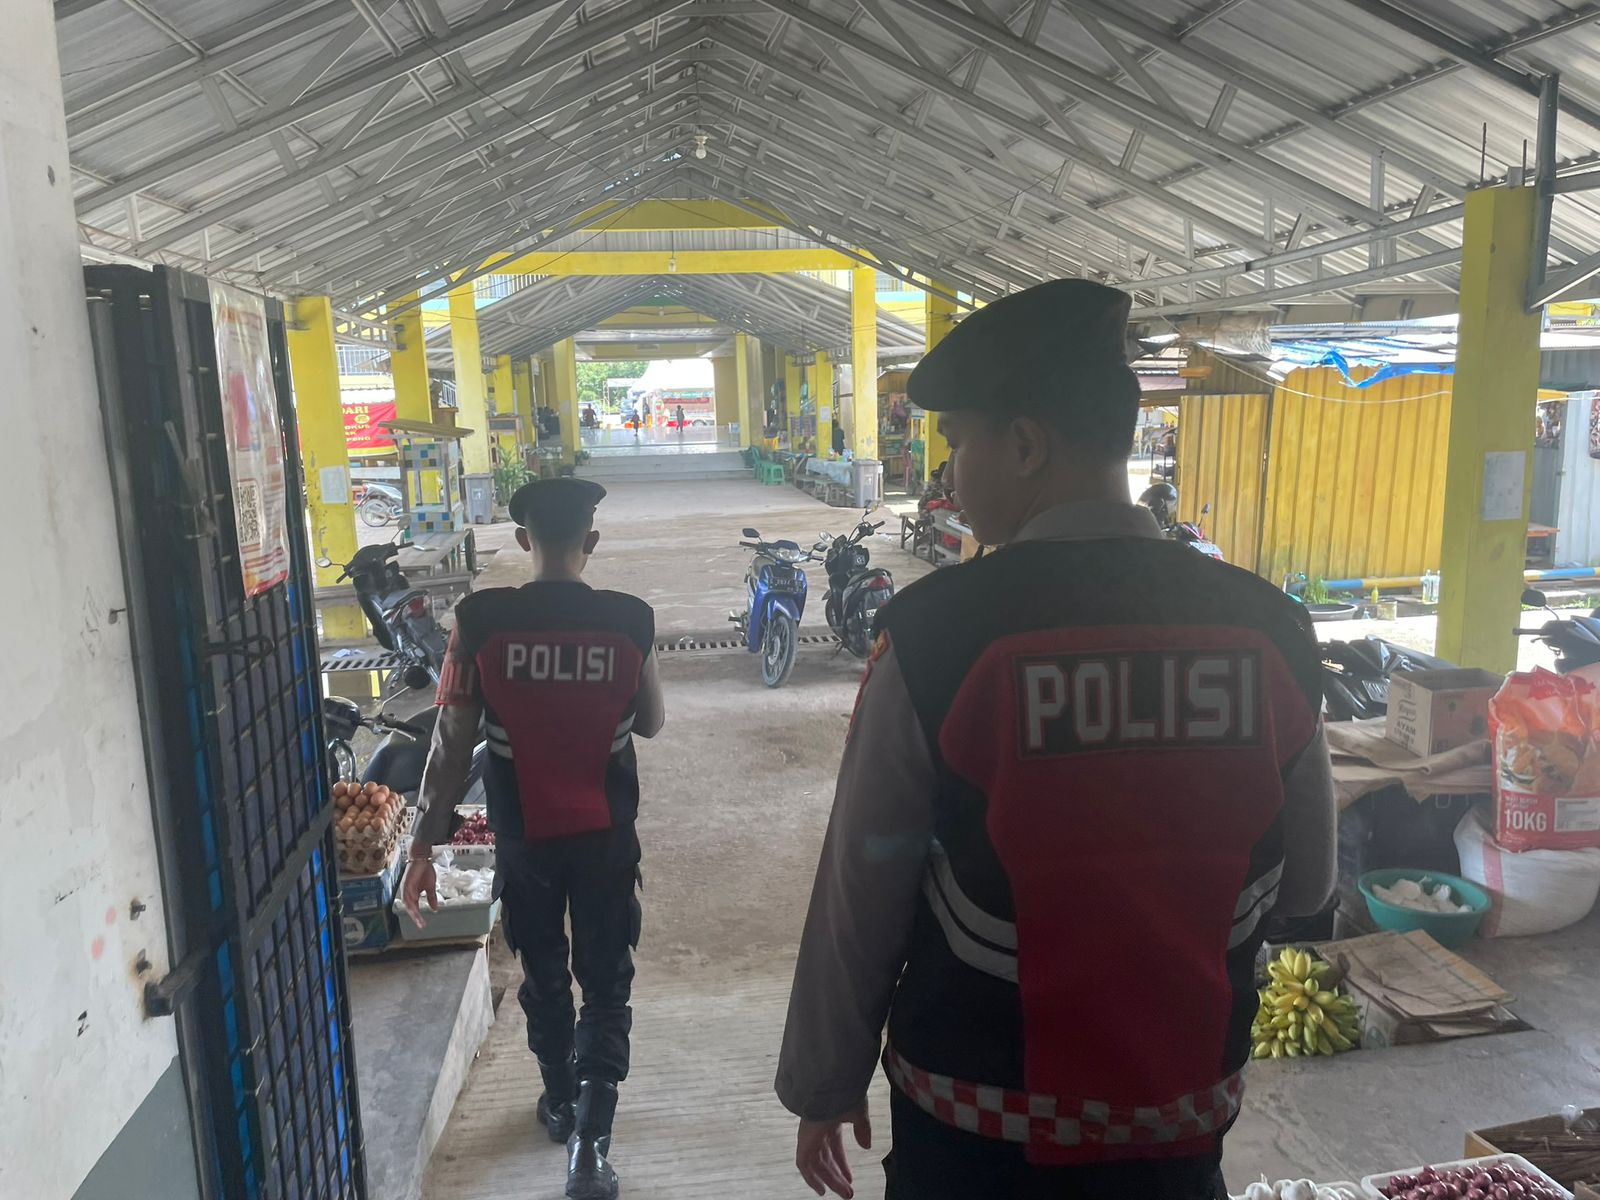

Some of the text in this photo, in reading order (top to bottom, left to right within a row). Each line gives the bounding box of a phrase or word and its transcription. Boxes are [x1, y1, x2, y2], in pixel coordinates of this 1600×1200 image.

[506, 643, 615, 682] POLISI
[1024, 657, 1254, 750] POLISI
[1504, 810, 1548, 832] 10KG
